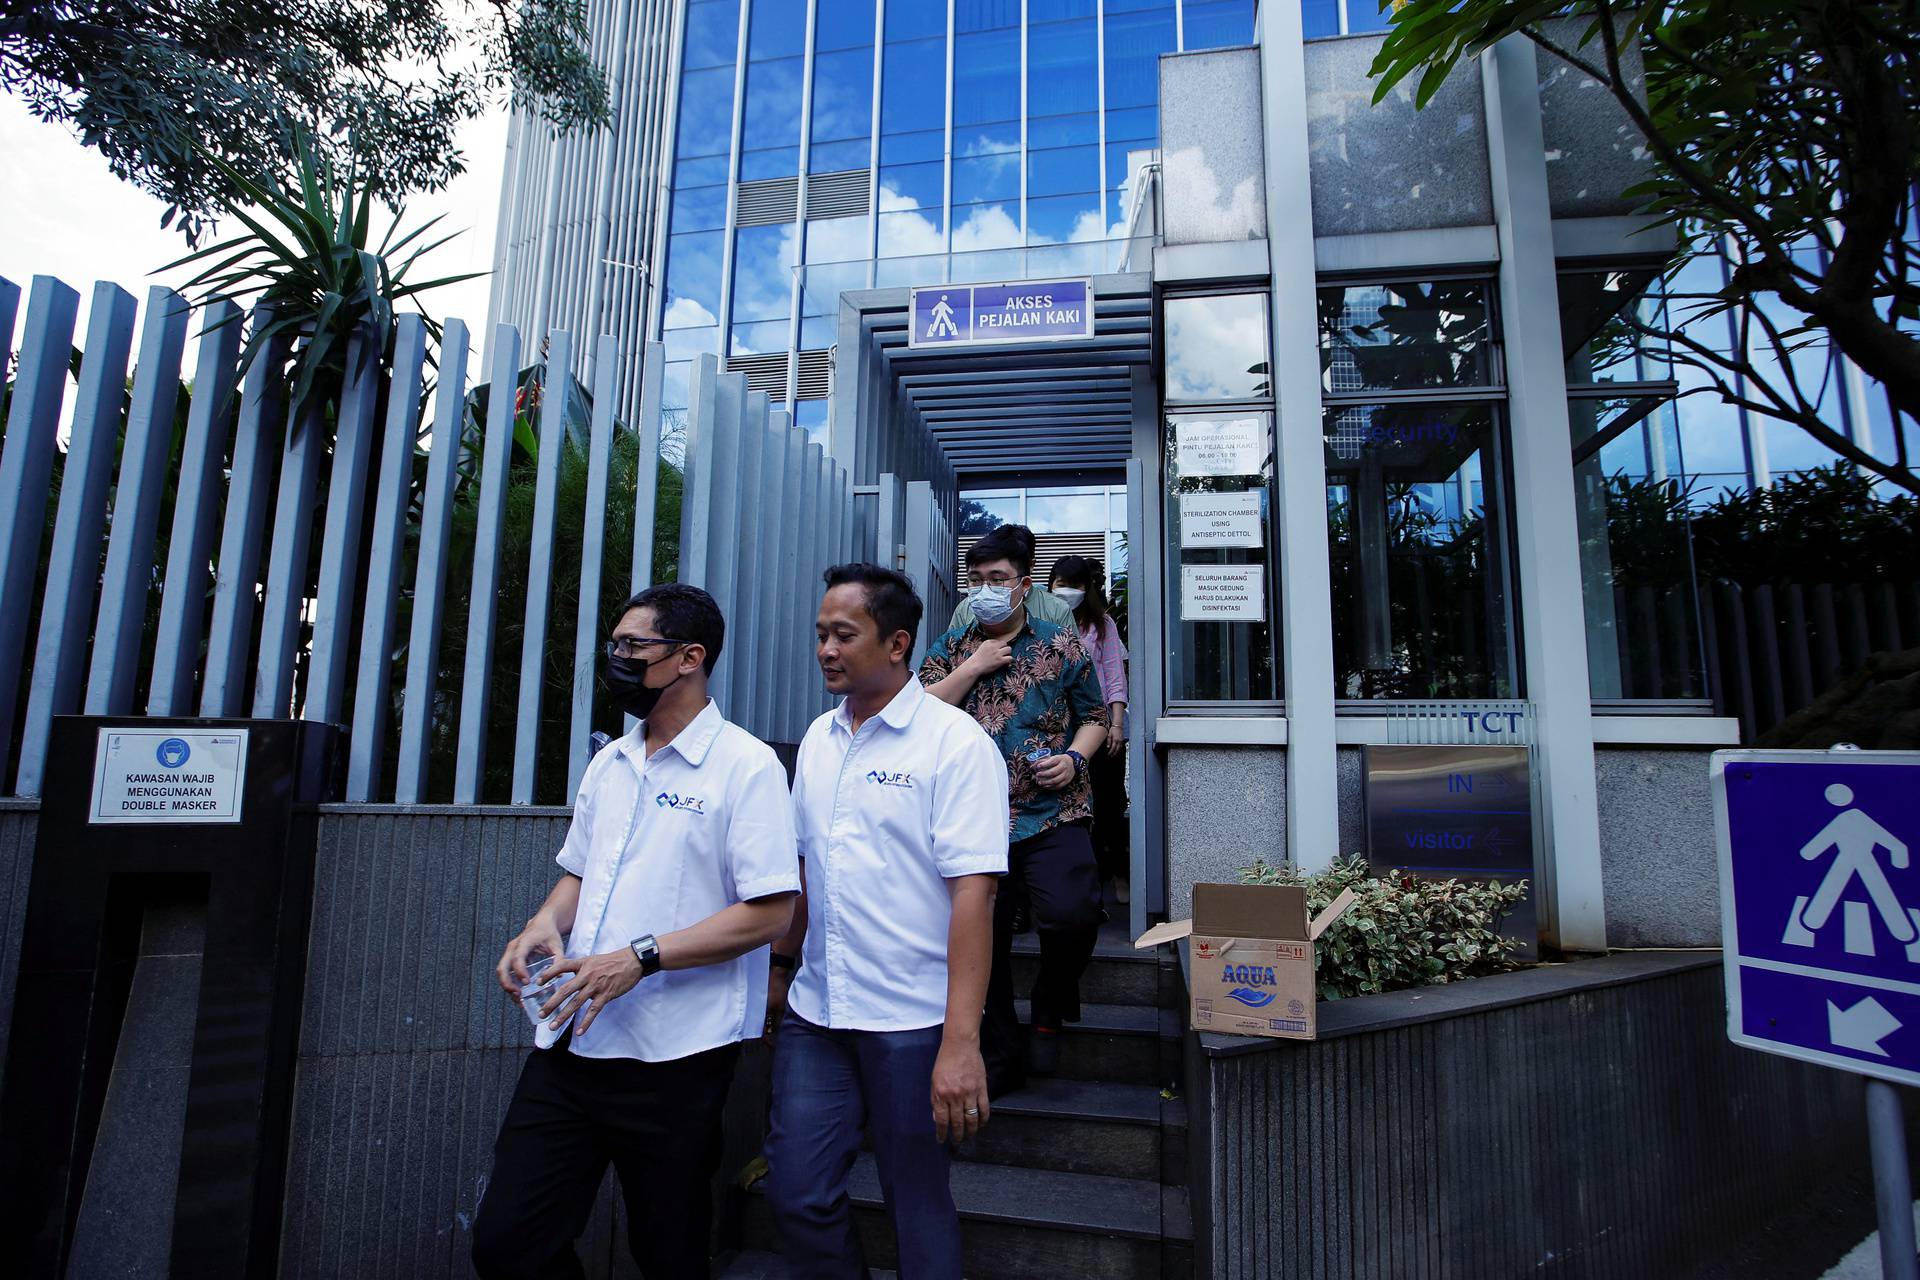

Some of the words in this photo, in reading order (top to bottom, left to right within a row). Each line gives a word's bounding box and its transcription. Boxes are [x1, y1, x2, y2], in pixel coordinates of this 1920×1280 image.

[1006, 295, 1053, 310] AKSES
[979, 312, 1040, 328] PEJALAN
[1046, 310, 1080, 324] KAKI
[1183, 510, 1227, 518] STERILIZATION
[1460, 711, 1524, 734] TCT
[126, 774, 179, 783] KAWASAN
[182, 774, 215, 783] WAJIB
[887, 773, 911, 784] JFX
[1448, 773, 1473, 794] IN
[127, 787, 212, 797] MENGGUNAKAN
[122, 800, 166, 810] DOUBLE
[172, 800, 217, 810] MASKER
[679, 796, 704, 810] JFX
[1221, 963, 1278, 988] AQUA
